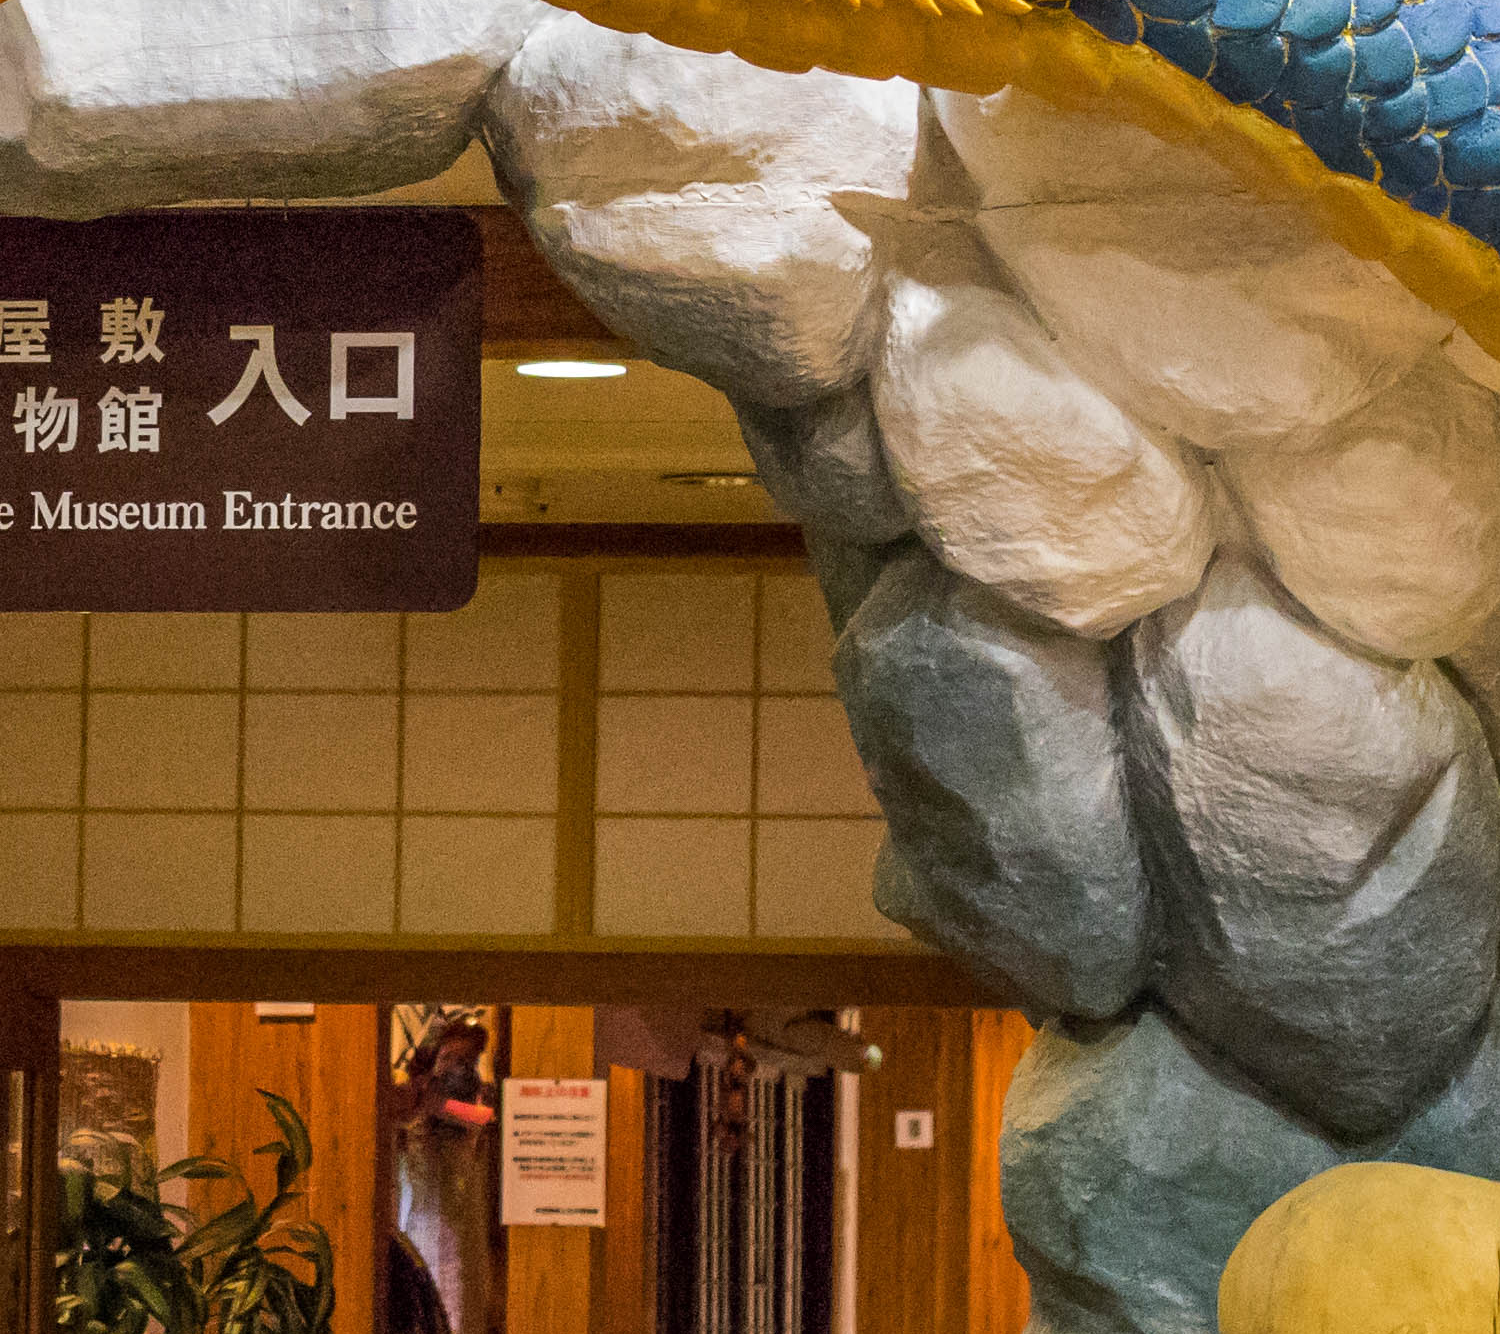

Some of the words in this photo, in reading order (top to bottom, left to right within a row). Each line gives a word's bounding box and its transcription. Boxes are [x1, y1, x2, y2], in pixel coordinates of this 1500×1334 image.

[205, 324, 416, 427] 入口
[31, 492, 206, 533] Museum
[221, 492, 418, 533] Entrance
